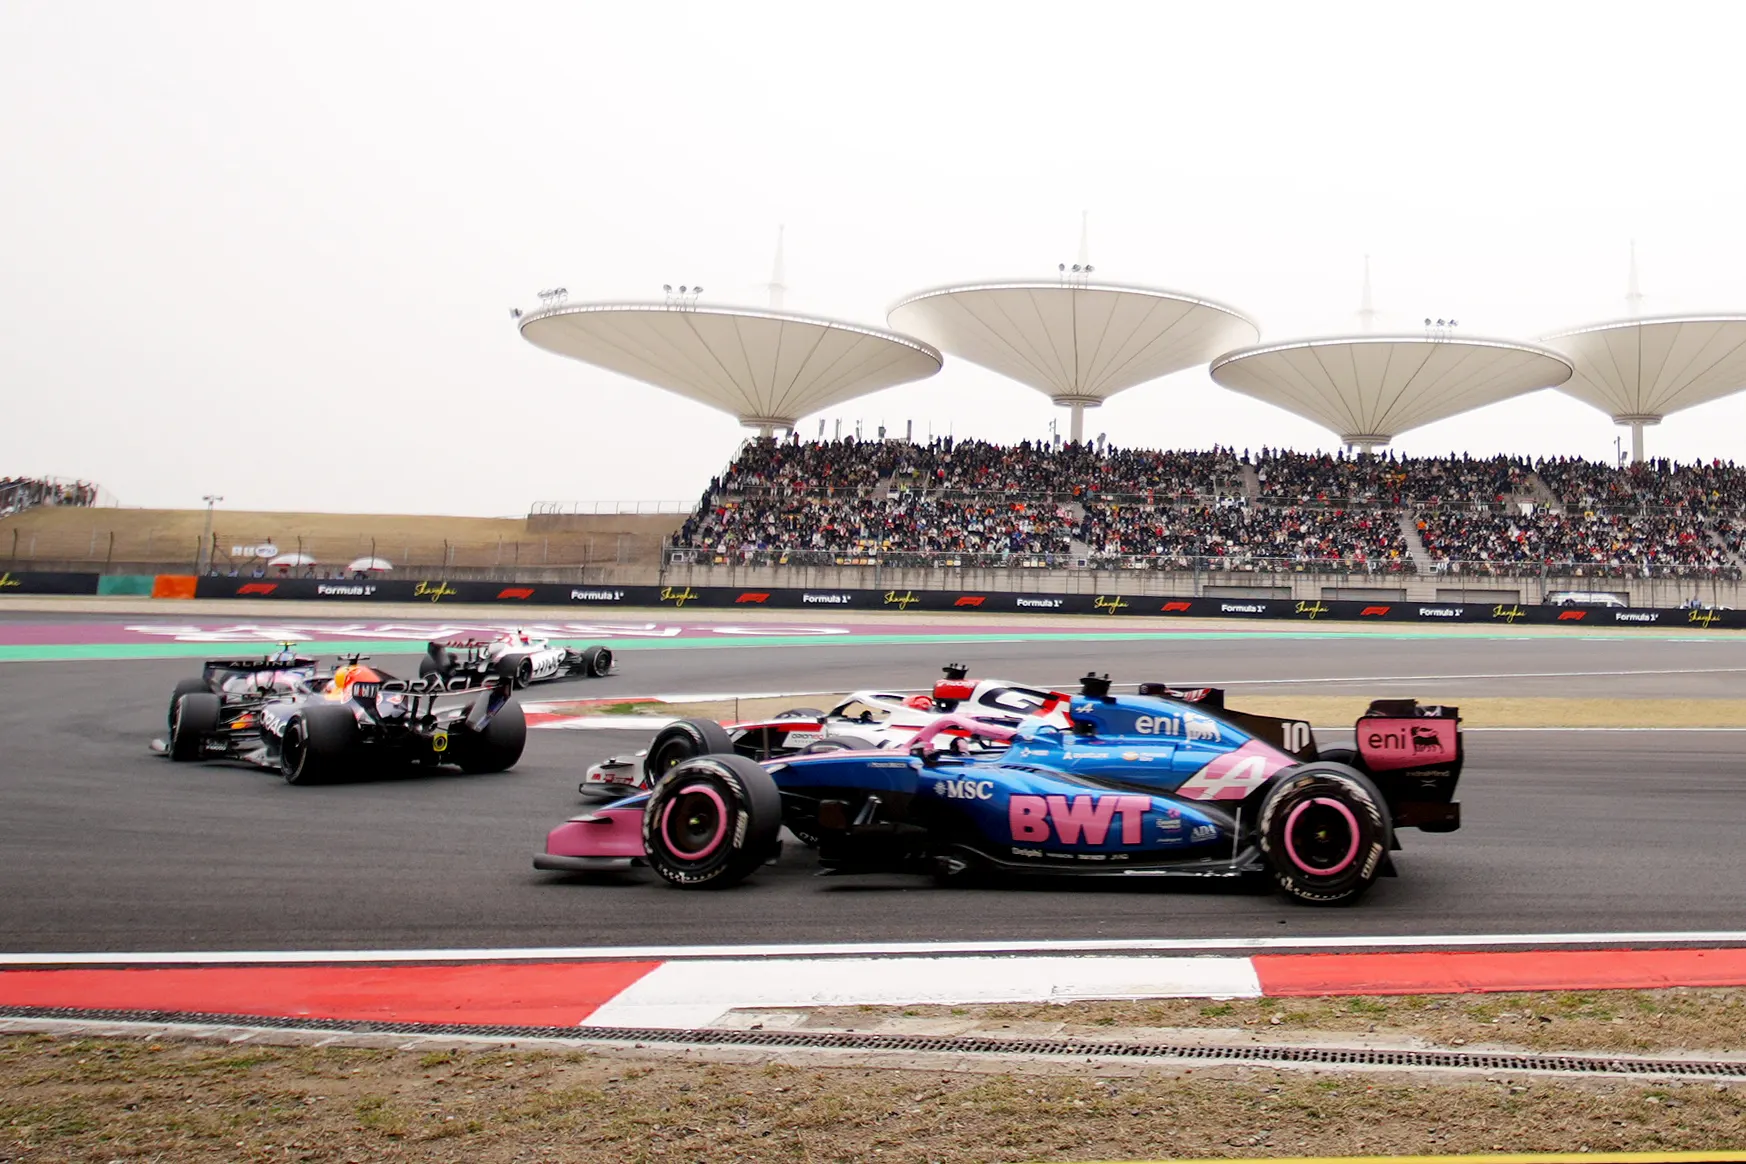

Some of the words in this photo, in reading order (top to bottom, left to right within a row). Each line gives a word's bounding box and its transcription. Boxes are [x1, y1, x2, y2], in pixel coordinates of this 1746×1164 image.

[317, 585, 363, 595] Formula
[414, 581, 456, 602] Shanghai
[571, 590, 612, 600] Formula
[660, 586, 699, 606] Shanghai
[803, 594, 841, 603] Formula
[884, 591, 919, 610] Shanghai
[1017, 599, 1053, 607] Formula
[1094, 596, 1128, 614] Shanghai
[1221, 604, 1256, 612] Formula
[1295, 601, 1329, 619] Shanghai
[1419, 608, 1453, 616] Formula
[1493, 605, 1526, 623] Shanghai
[1689, 610, 1721, 628] Shanghai
[260, 710, 287, 738] ORAC
[1135, 712, 1180, 735] eni
[1281, 722, 1310, 754] 10
[1368, 728, 1406, 749] eni
[946, 780, 994, 800] MSC
[1009, 794, 1151, 845] BWT
